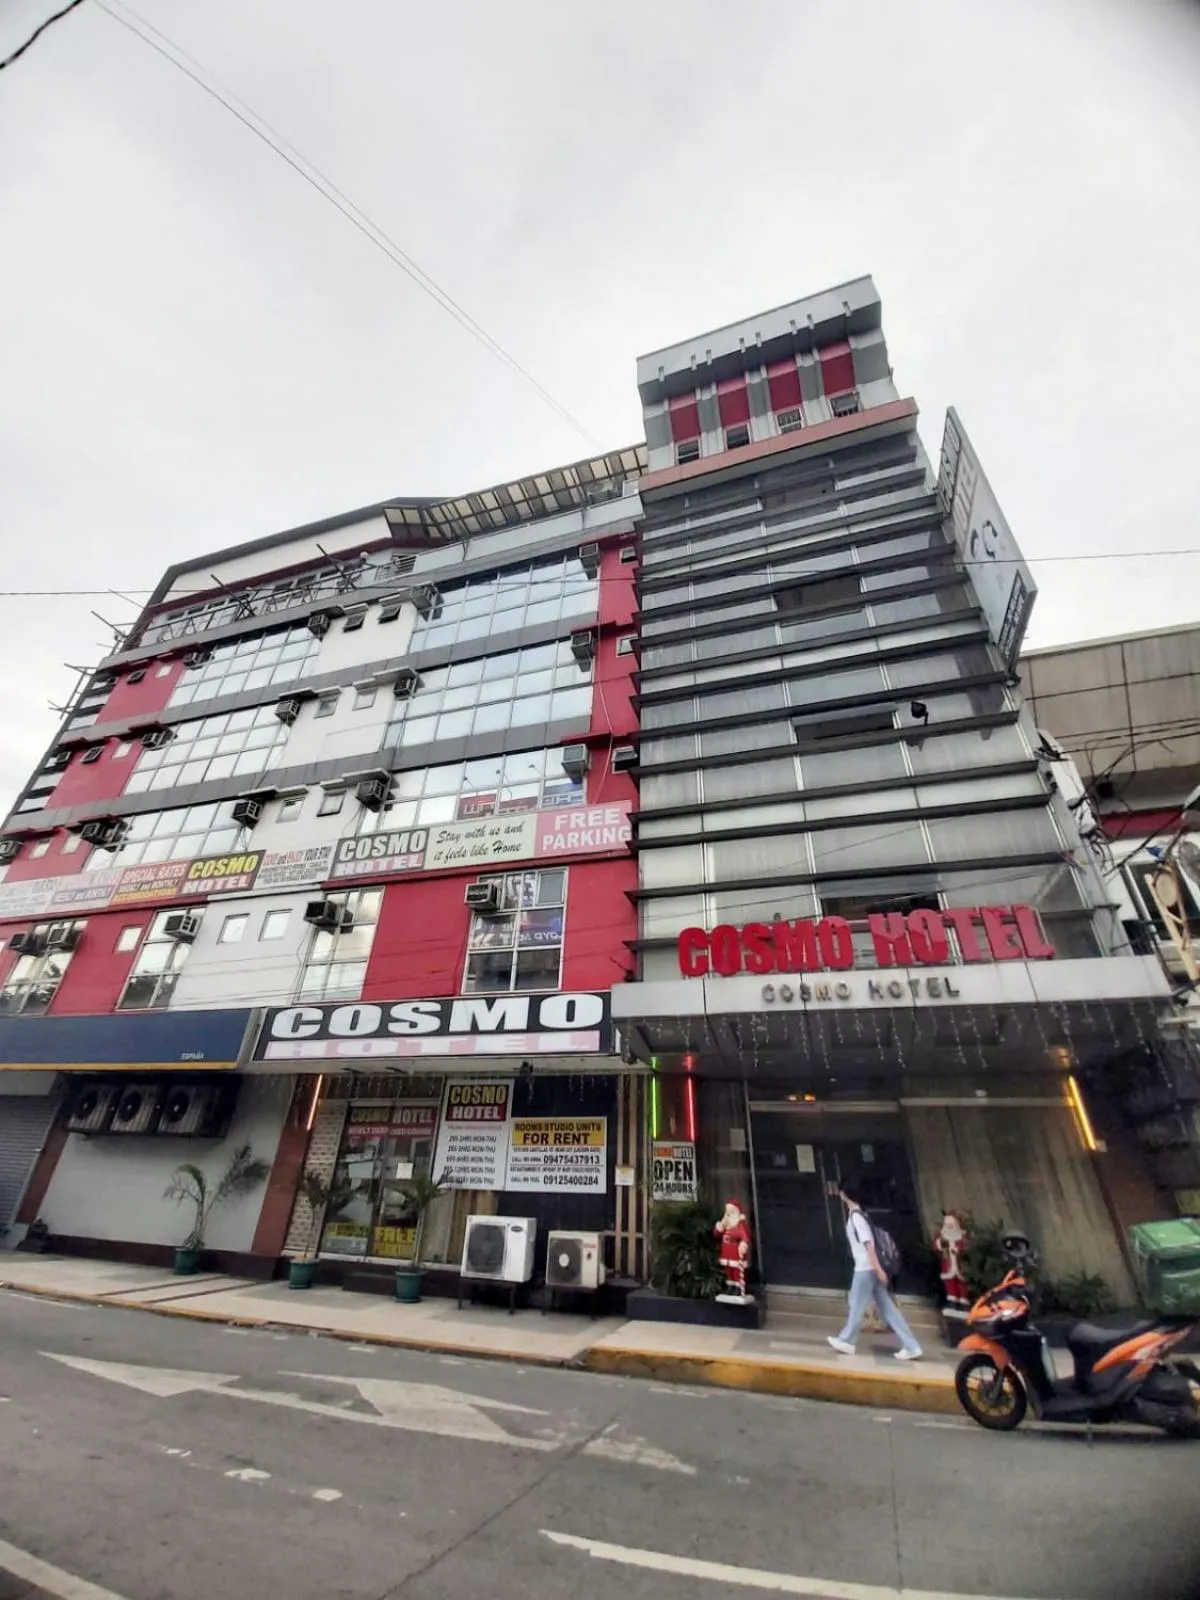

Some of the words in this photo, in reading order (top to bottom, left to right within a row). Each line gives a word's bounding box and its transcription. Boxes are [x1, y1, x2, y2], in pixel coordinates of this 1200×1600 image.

[555, 808, 620, 831] FREE
[436, 830, 462, 845] Stay
[464, 825, 487, 839] with
[489, 827, 501, 836] us
[504, 821, 525, 834] and
[543, 827, 632, 851] PARKING
[339, 830, 426, 863] COSMO
[433, 850, 443, 861] it
[444, 845, 467, 863] feels
[470, 843, 488, 857] like
[492, 840, 522, 854] Home
[188, 855, 259, 879] COSMO
[334, 851, 424, 878] HOTEL
[180, 874, 249, 894] HOTEL
[678, 915, 854, 978] COSMO
[867, 905, 1056, 967] HOTEL
[762, 978, 852, 1004] COSMO
[868, 976, 960, 1001] HOTEL
[271, 994, 604, 1038] COSMO
[264, 1031, 600, 1059] HOTEL
[450, 1085, 506, 1104] COSMO
[351, 1107, 391, 1124] COSMO
[392, 1107, 434, 1124] HOTEL
[451, 1106, 501, 1120] HOTEL
[523, 1132, 549, 1144] FOR
[553, 1132, 590, 1144] RENT
[544, 1122, 574, 1132] STUDIO
[576, 1122, 602, 1132] UNITS
[654, 1159, 693, 1181] OPEN
